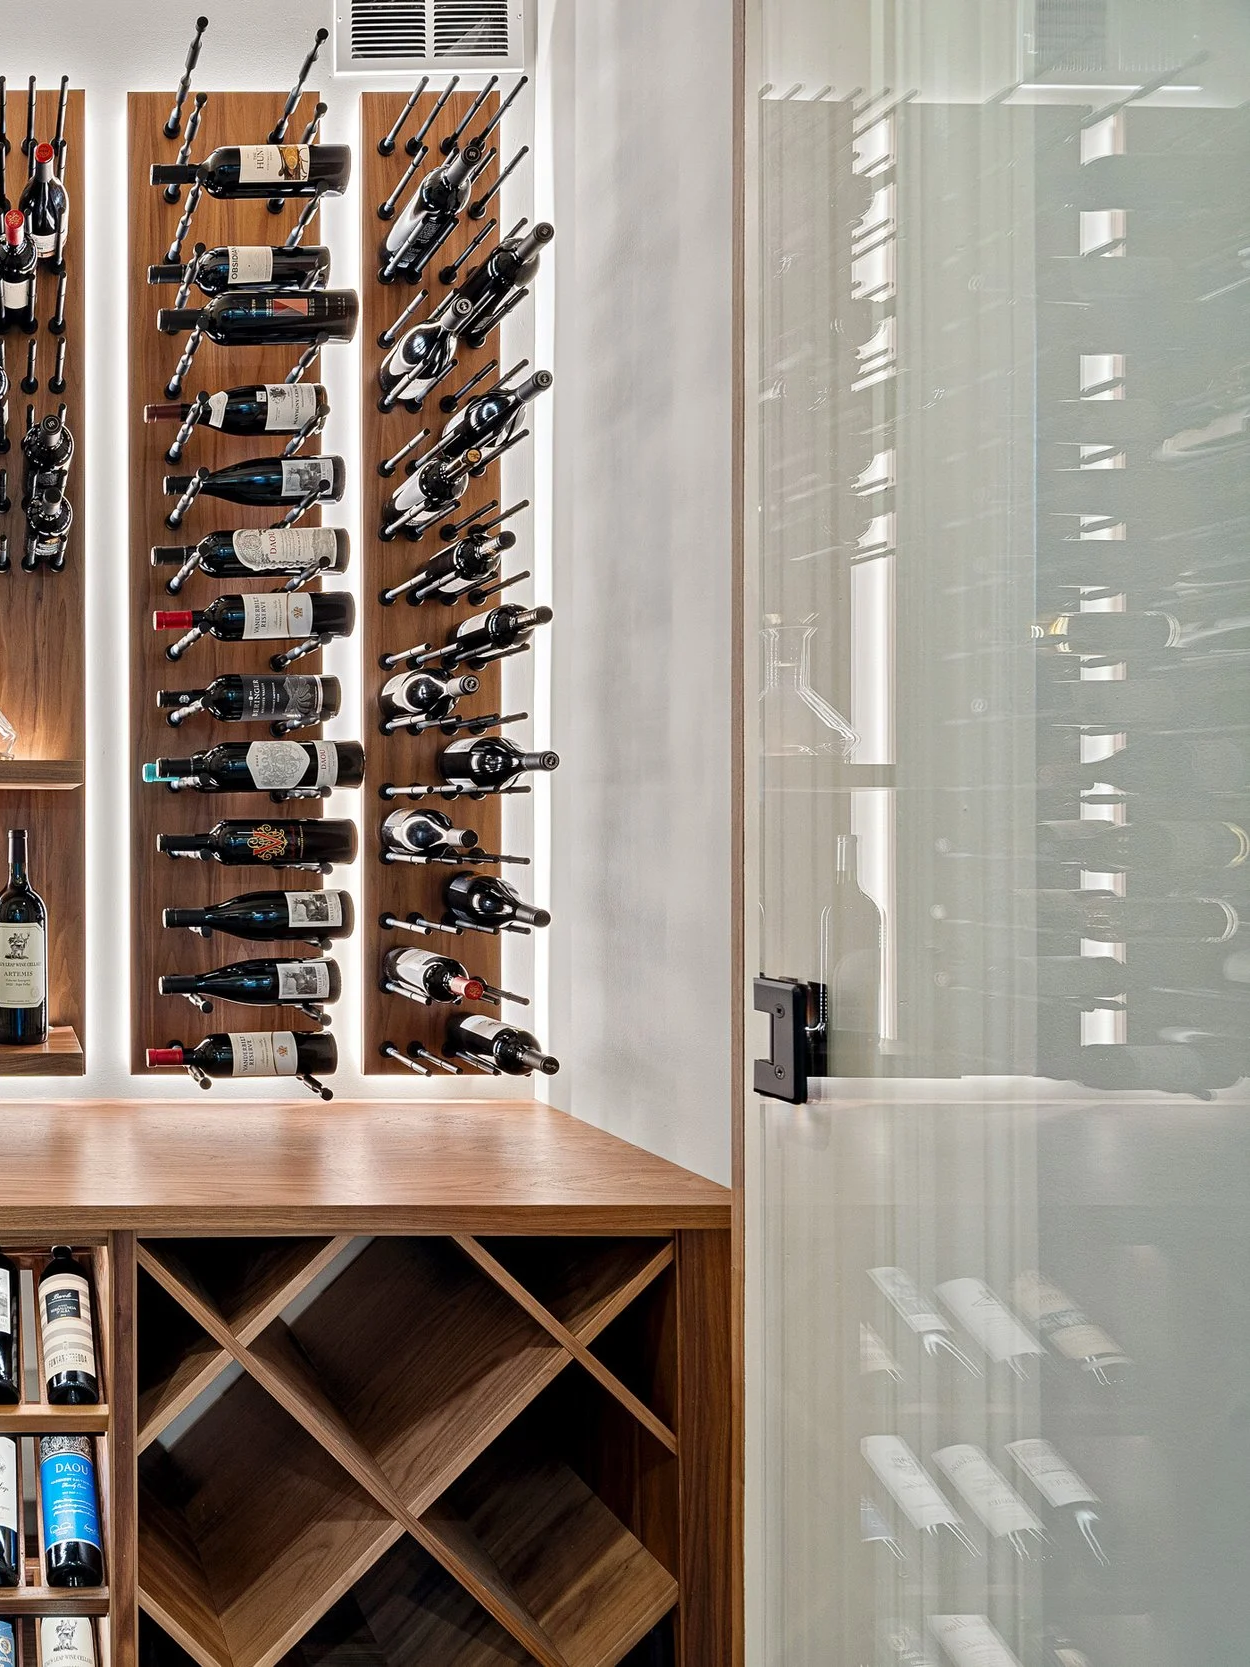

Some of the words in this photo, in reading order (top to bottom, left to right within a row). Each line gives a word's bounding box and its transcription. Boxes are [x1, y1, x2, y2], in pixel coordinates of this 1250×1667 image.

[252, 679, 260, 718] BERINGER
[239, 1036, 248, 1072] VANDERBILT
[55, 1461, 89, 1475] DAOU
